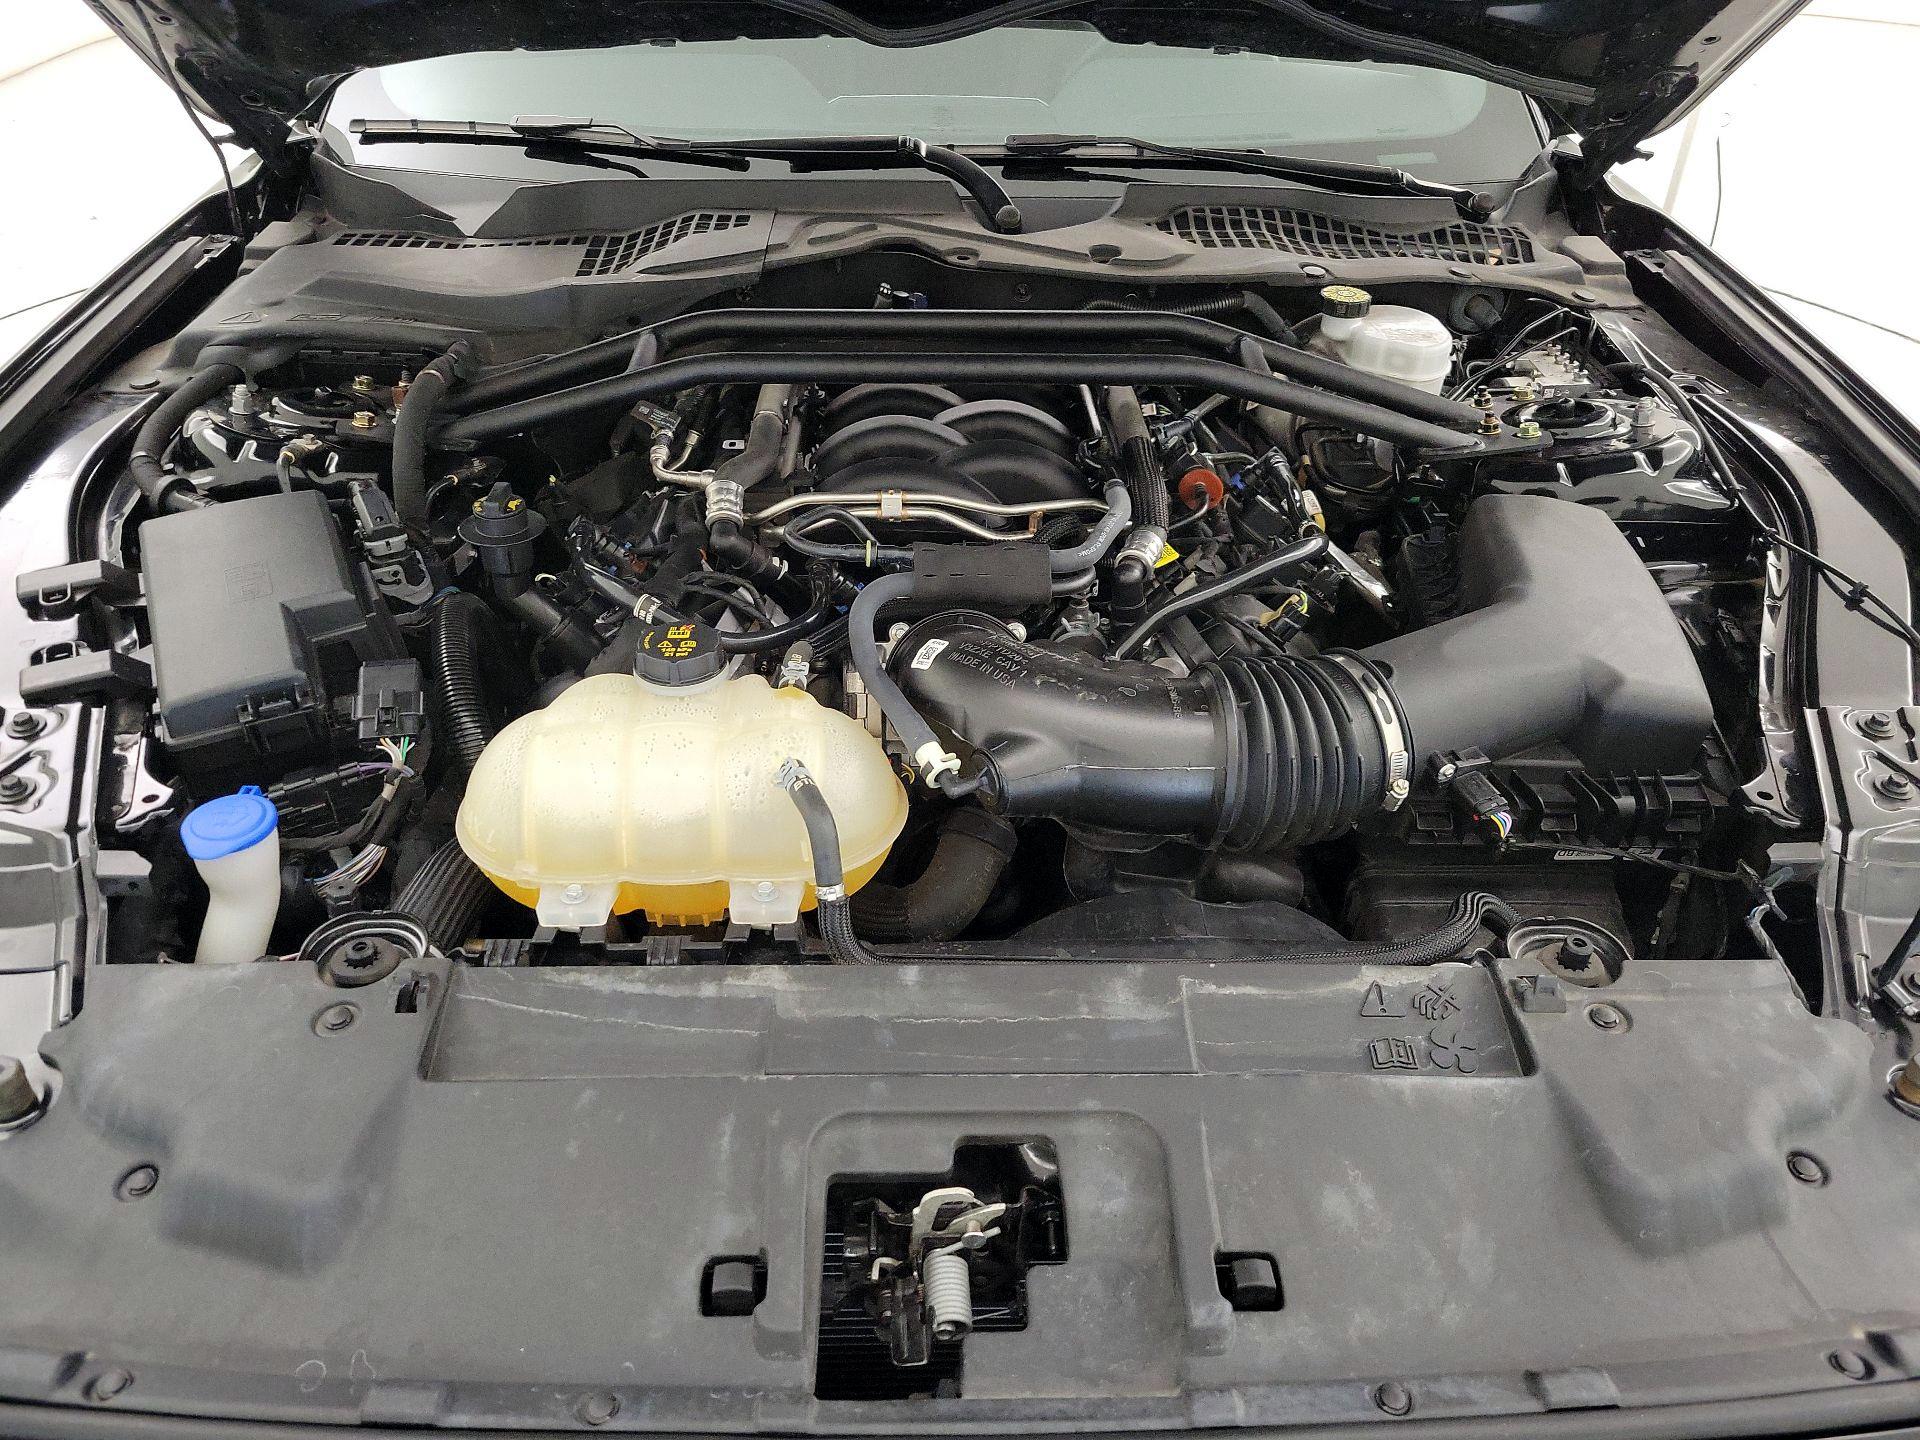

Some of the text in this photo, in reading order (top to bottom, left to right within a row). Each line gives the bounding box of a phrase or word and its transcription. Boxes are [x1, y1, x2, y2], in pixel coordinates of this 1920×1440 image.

[947, 651, 981, 668] MADE
[979, 662, 994, 675] IN
[993, 668, 1016, 690] USA
